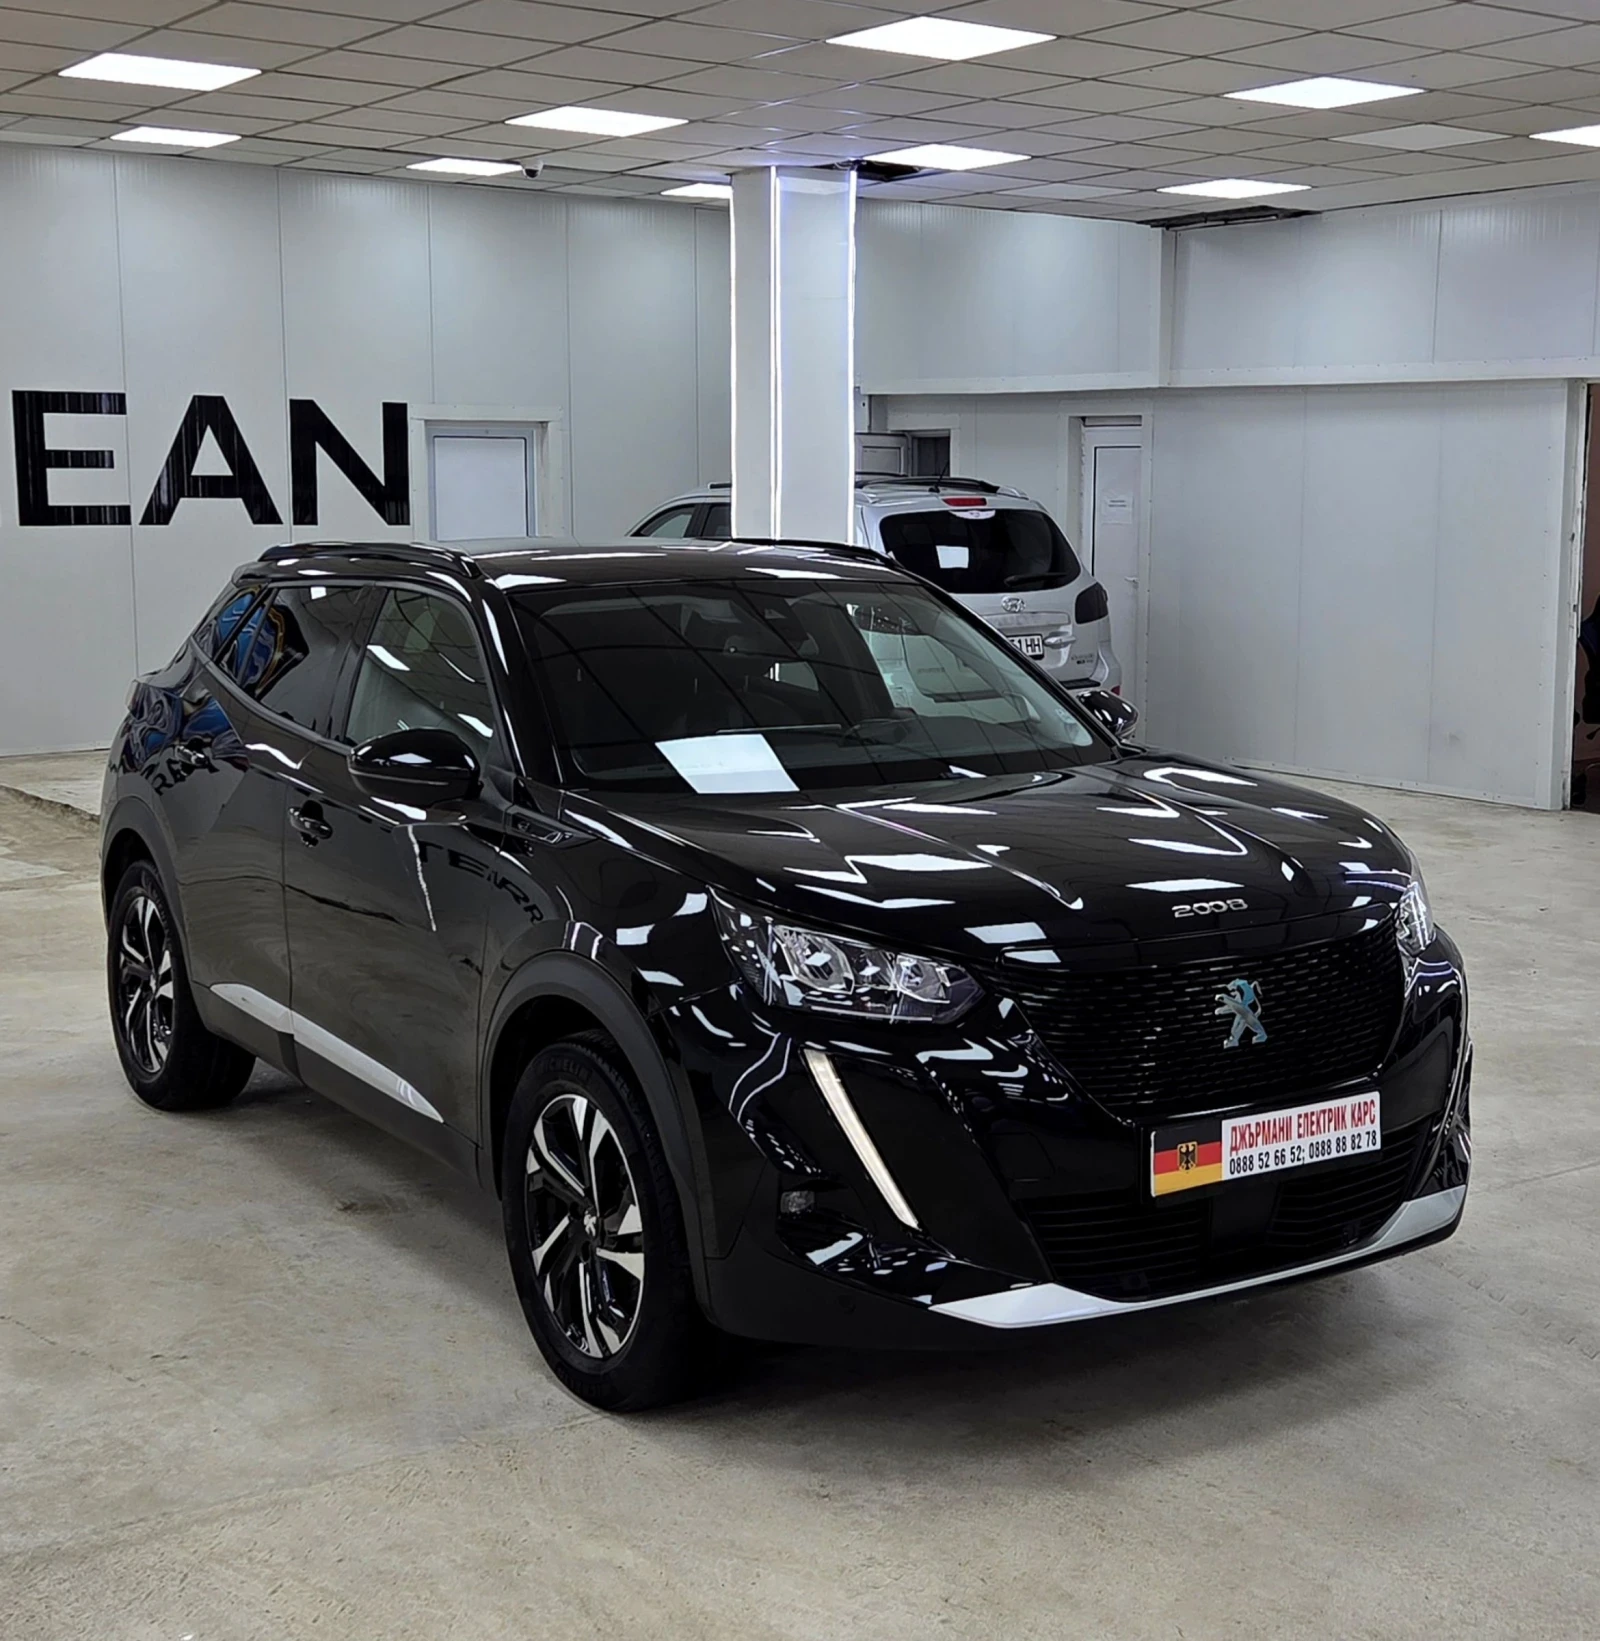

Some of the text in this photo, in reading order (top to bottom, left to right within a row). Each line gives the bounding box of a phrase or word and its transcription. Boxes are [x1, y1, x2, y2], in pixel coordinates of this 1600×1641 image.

[12, 390, 411, 526] EAN
[1171, 898, 1249, 918] 2008
[1229, 1155, 1254, 1175] 0888
[1258, 1151, 1270, 1170] 52
[1274, 1148, 1286, 1166] 66
[1308, 1138, 1332, 1160] 0888
[1335, 1136, 1347, 1154] 88
[1351, 1132, 1362, 1151] 82
[1365, 1129, 1377, 1148] 78
[1230, 1099, 1376, 1157] ДЖЪРМАНИ ЕЛЕКТРИК КАРС
